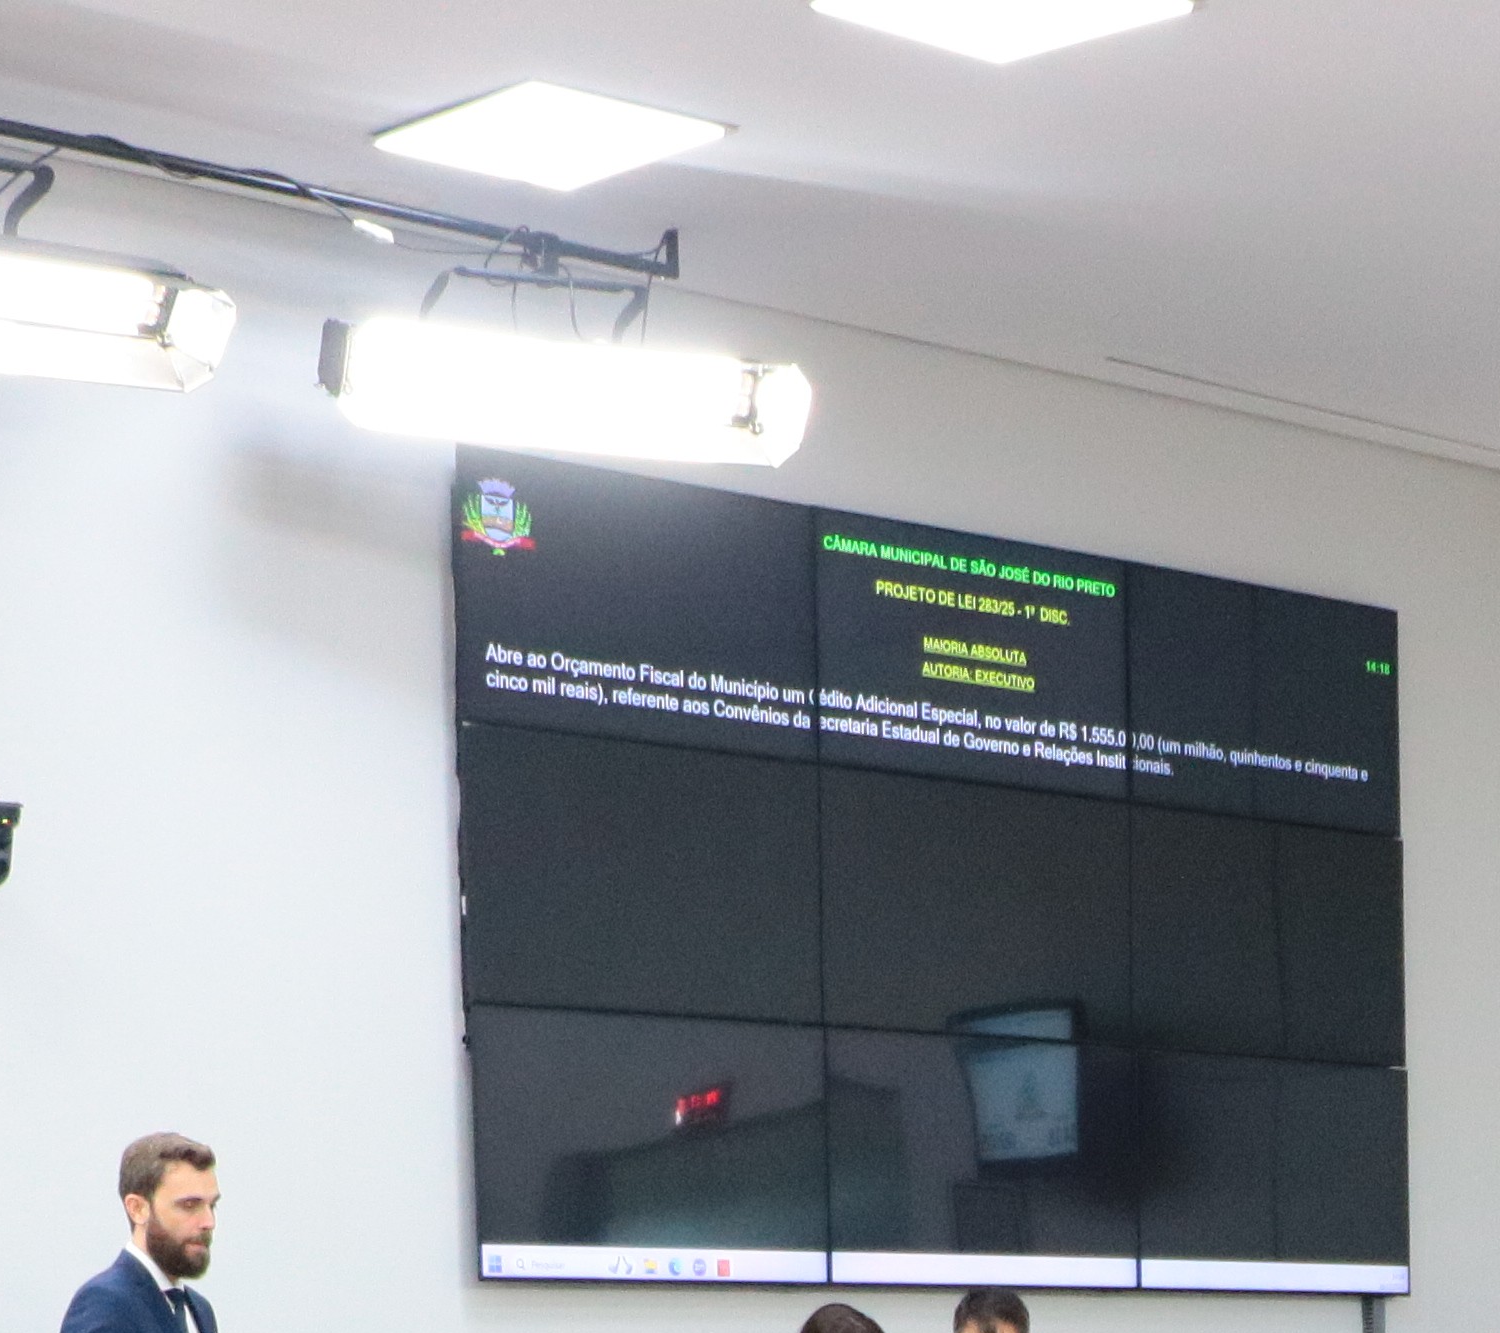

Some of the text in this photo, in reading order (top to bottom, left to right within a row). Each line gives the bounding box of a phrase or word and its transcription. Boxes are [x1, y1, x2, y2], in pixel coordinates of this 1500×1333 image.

[823, 534, 1115, 598] CÂMARA MUNICIPAL DE SÃO JOSÉ DO RIO PRETO
[876, 580, 935, 604] PROJETO
[938, 590, 955, 608] DE
[958, 593, 977, 611] LEI
[1040, 606, 1071, 626] DISC.
[923, 636, 1027, 666] MAIORIA ABSOLUTA
[1365, 660, 1391, 676] 14:18
[975, 669, 1035, 692] EXECUTIVO
[485, 642, 523, 666] Abre
[527, 652, 547, 669] ao
[551, 652, 636, 681] Orçamento
[640, 664, 684, 688] Fiscal
[688, 672, 707, 691] do
[711, 674, 779, 702] Município
[783, 689, 805, 705] um
[856, 693, 918, 719] Adicional
[921, 702, 982, 729] Especial,
[985, 715, 1002, 729] no
[1004, 716, 1037, 735] valor
[1040, 720, 1056, 737] de
[1059, 721, 1077, 741] R$
[1158, 735, 1181, 755] (um
[1184, 741, 1227, 763] milhão,
[1230, 748, 1292, 772] quinhentos
[1294, 761, 1302, 772] e
[1304, 758, 1358, 782] cinquenta
[1360, 769, 1368, 782] e
[486, 669, 529, 692] cinco
[532, 676, 556, 695] mil
[560, 682, 608, 706] reais),
[612, 687, 679, 711] referente
[682, 700, 710, 715] aos
[714, 699, 790, 726] Convênios
[793, 710, 811, 729] da
[882, 720, 940, 745] Estadual
[943, 730, 960, 747] de
[963, 732, 1019, 756] Governo
[1022, 744, 1031, 757] e
[1034, 741, 1094, 767] Relações
